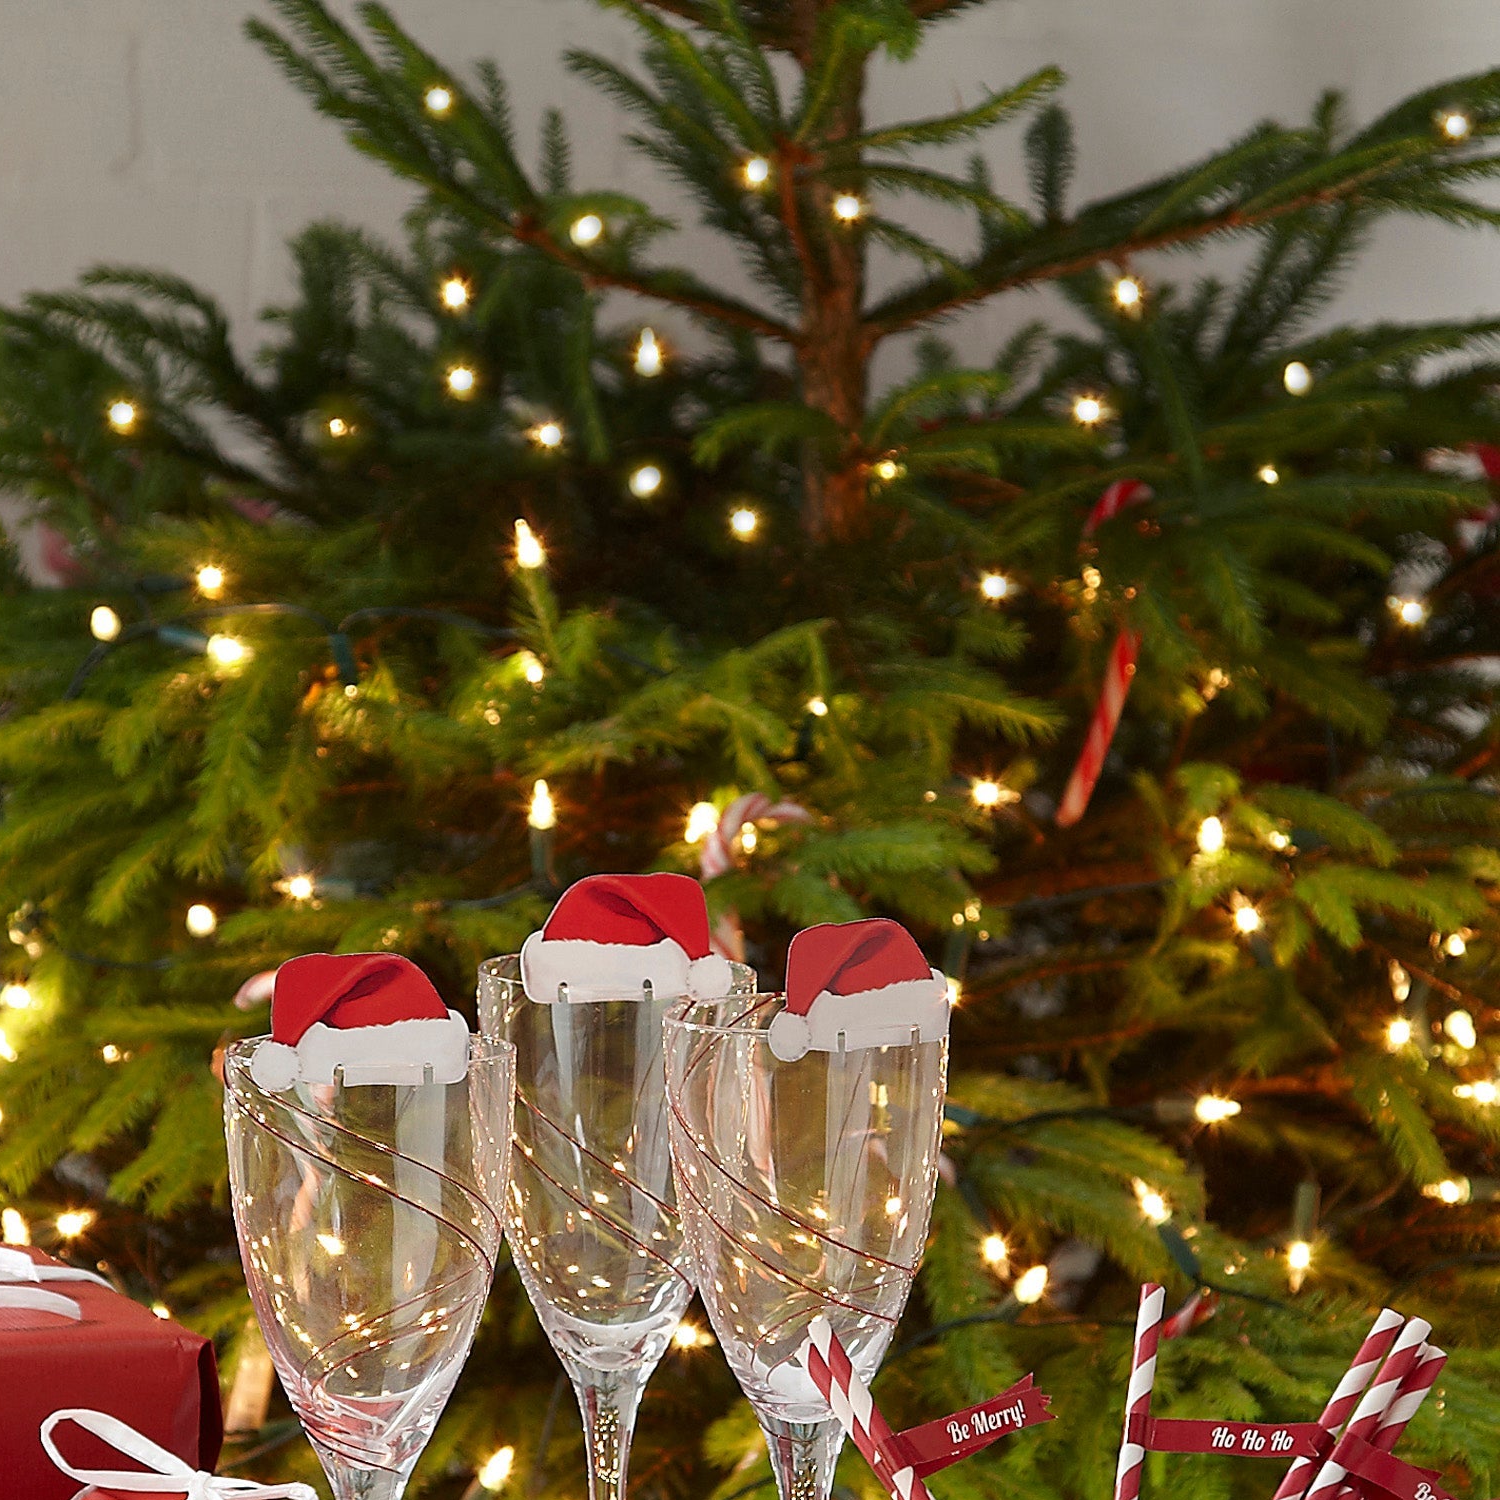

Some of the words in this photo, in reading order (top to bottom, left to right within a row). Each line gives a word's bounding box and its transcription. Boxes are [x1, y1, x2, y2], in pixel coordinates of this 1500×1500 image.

[946, 1420, 970, 1443] Be
[970, 1399, 1027, 1436] Merry!
[1211, 1426, 1236, 1448] Ho
[1241, 1429, 1266, 1451] Ho
[1270, 1430, 1294, 1451] Ho
